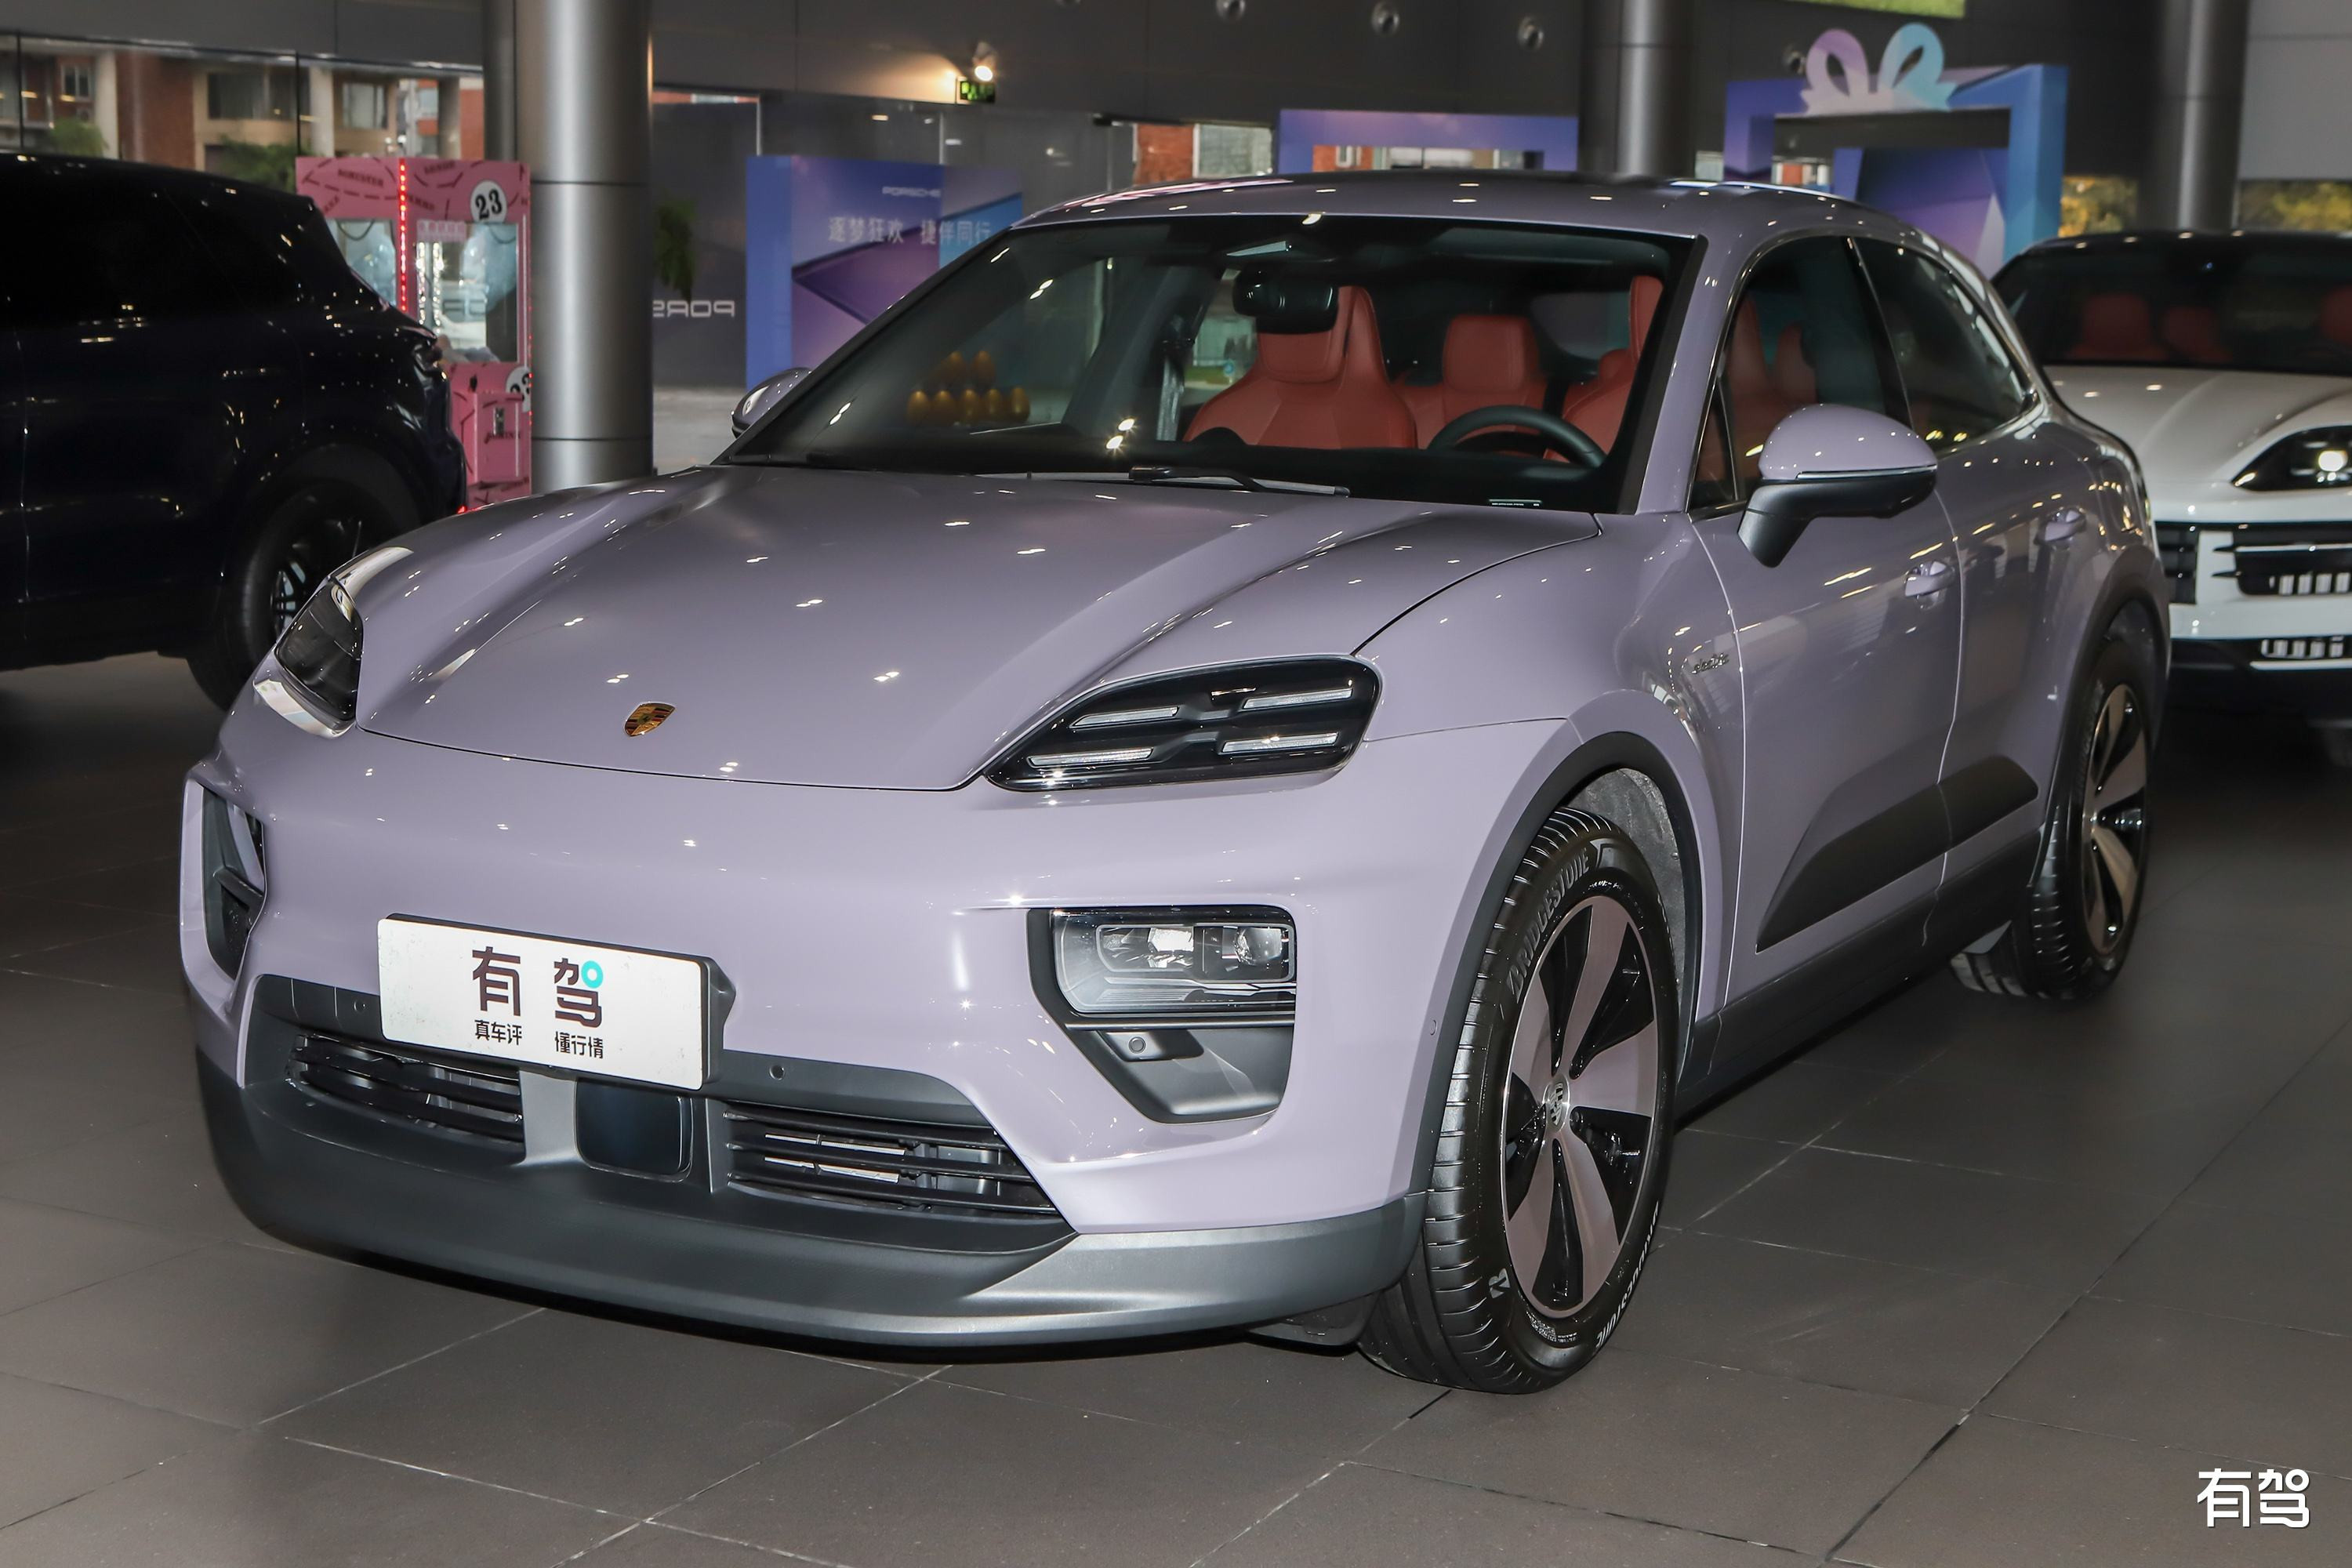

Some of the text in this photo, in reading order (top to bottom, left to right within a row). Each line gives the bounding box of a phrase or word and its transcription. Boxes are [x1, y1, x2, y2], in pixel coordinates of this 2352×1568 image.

[475, 189, 503, 220] 23
[828, 216, 904, 244] 逐梦狂欢
[1506, 847, 1590, 1004] BRIDGESTONE
[474, 1019, 604, 1059] 真车评 懂行情
